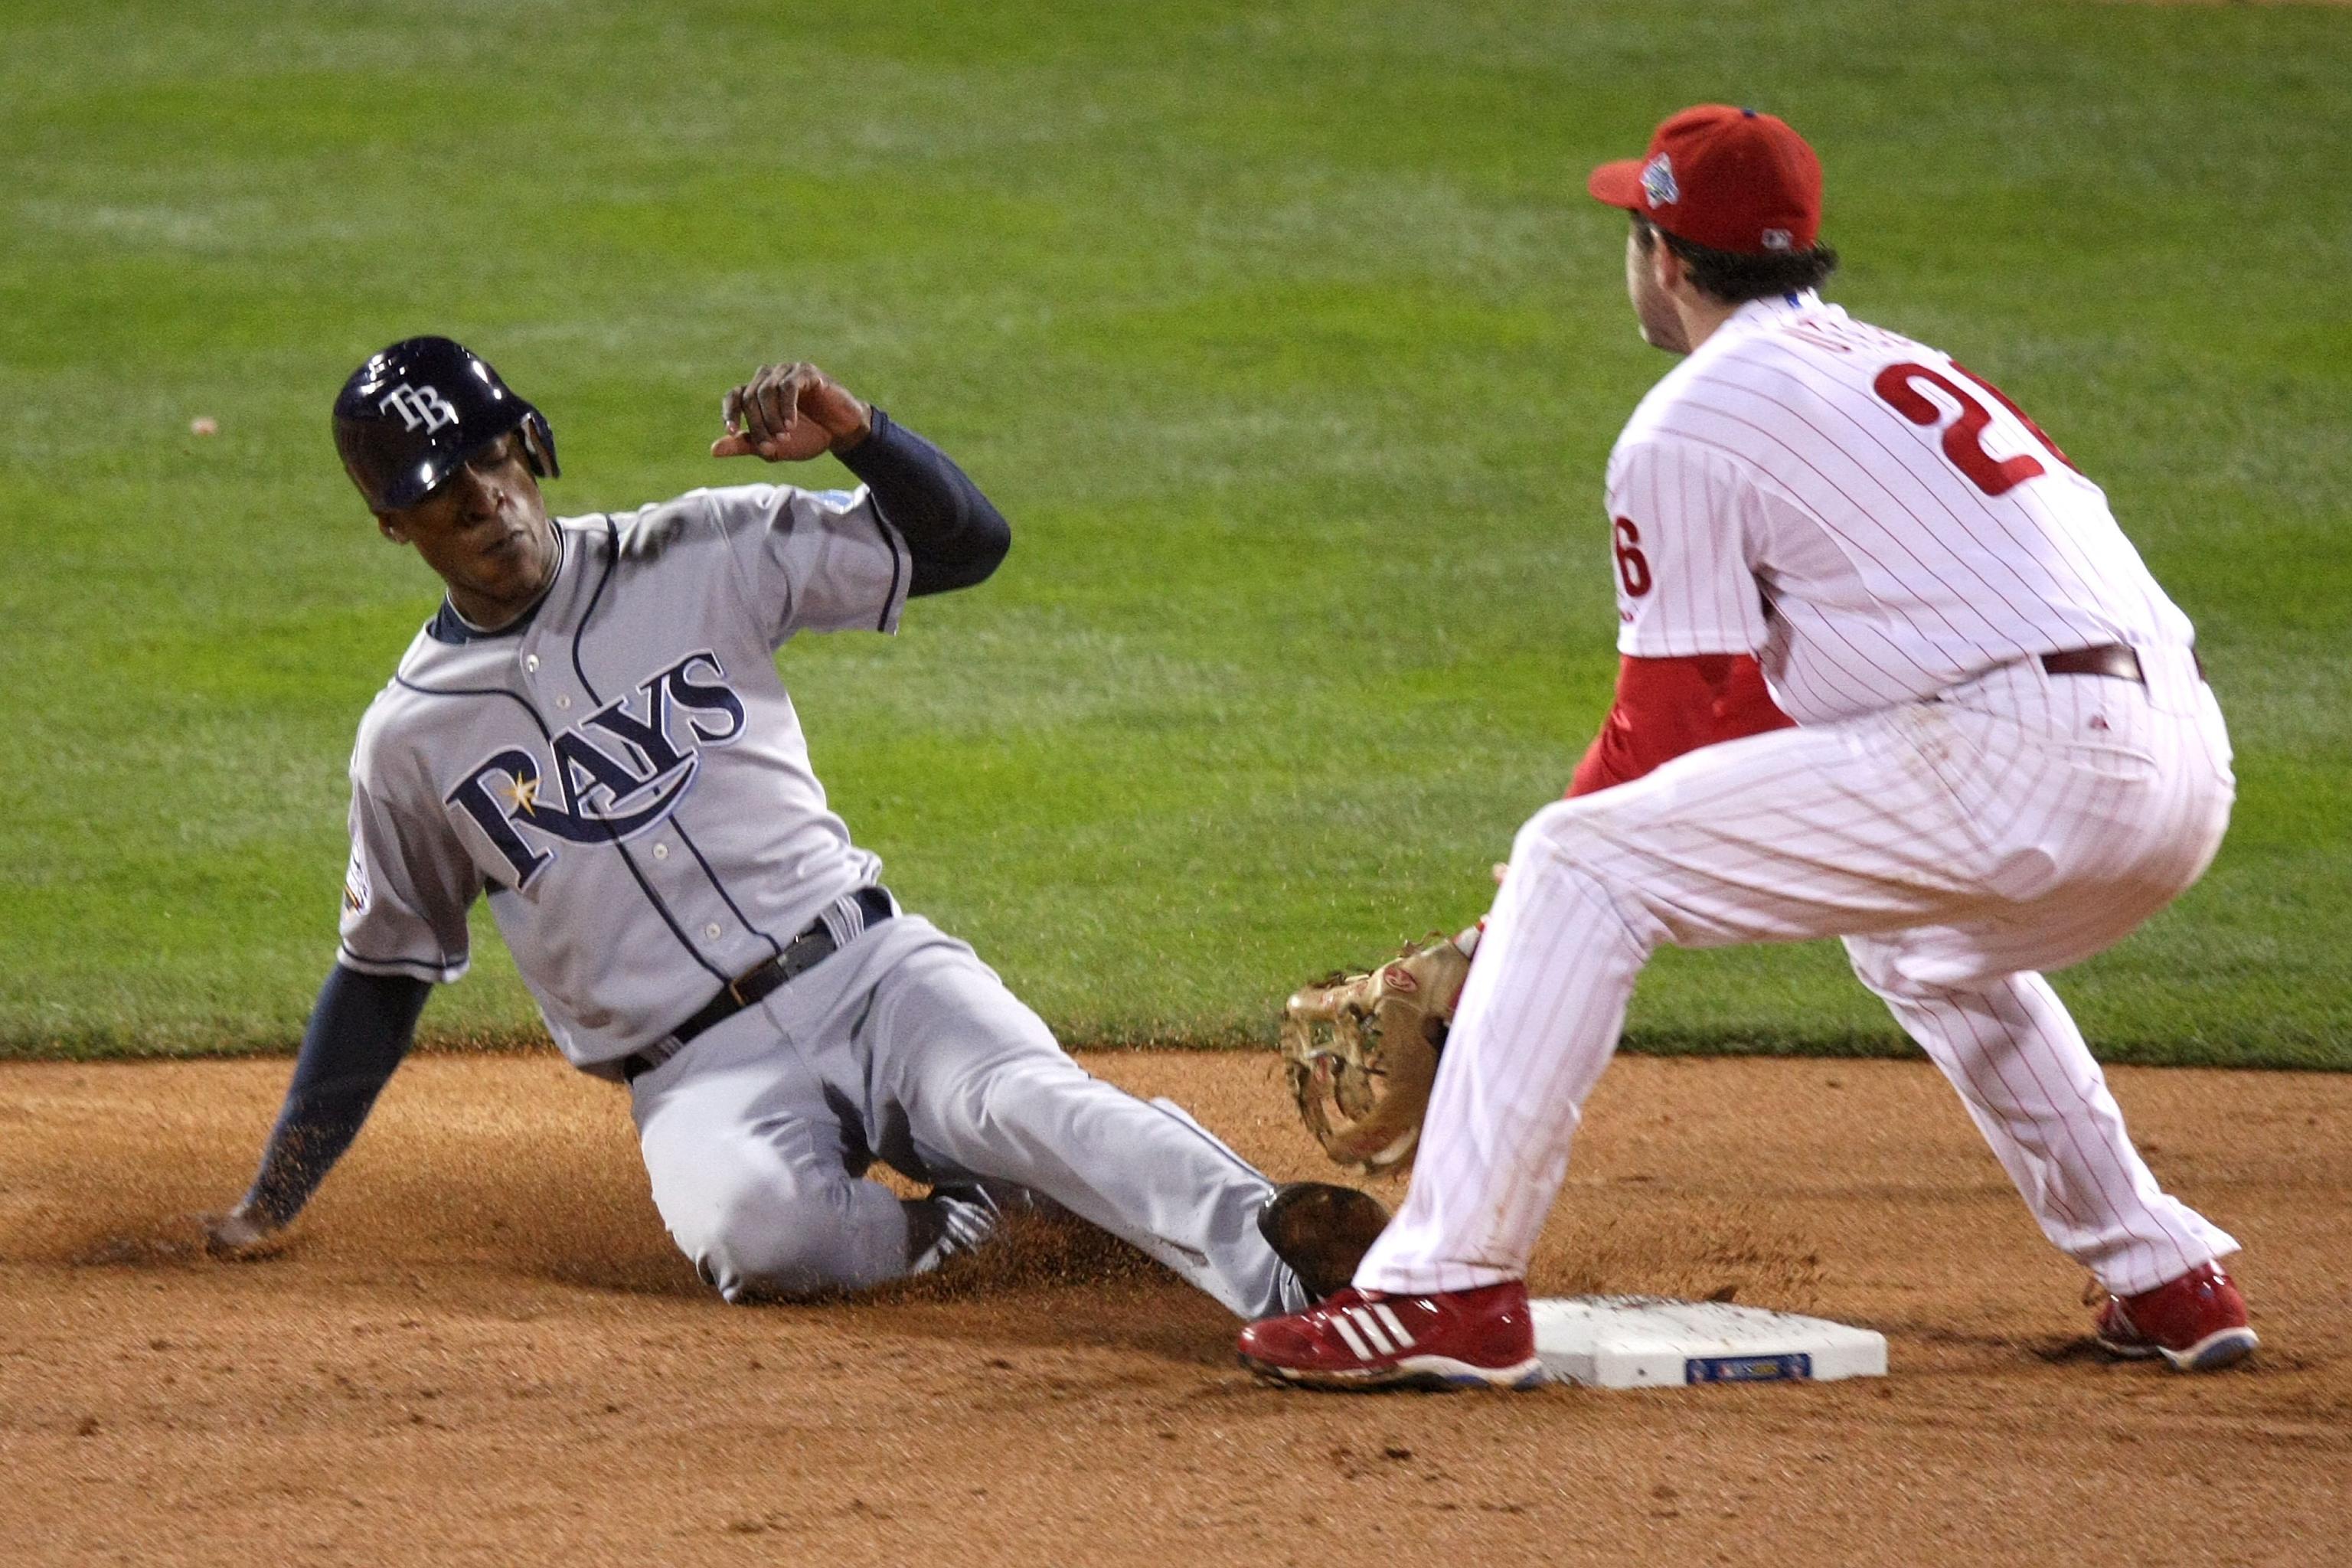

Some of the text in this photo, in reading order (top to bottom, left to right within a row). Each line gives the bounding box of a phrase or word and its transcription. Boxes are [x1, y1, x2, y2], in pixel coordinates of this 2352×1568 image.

[379, 382, 459, 436] TB
[1873, 362, 2084, 498] 2
[443, 648, 747, 893] RAYS
